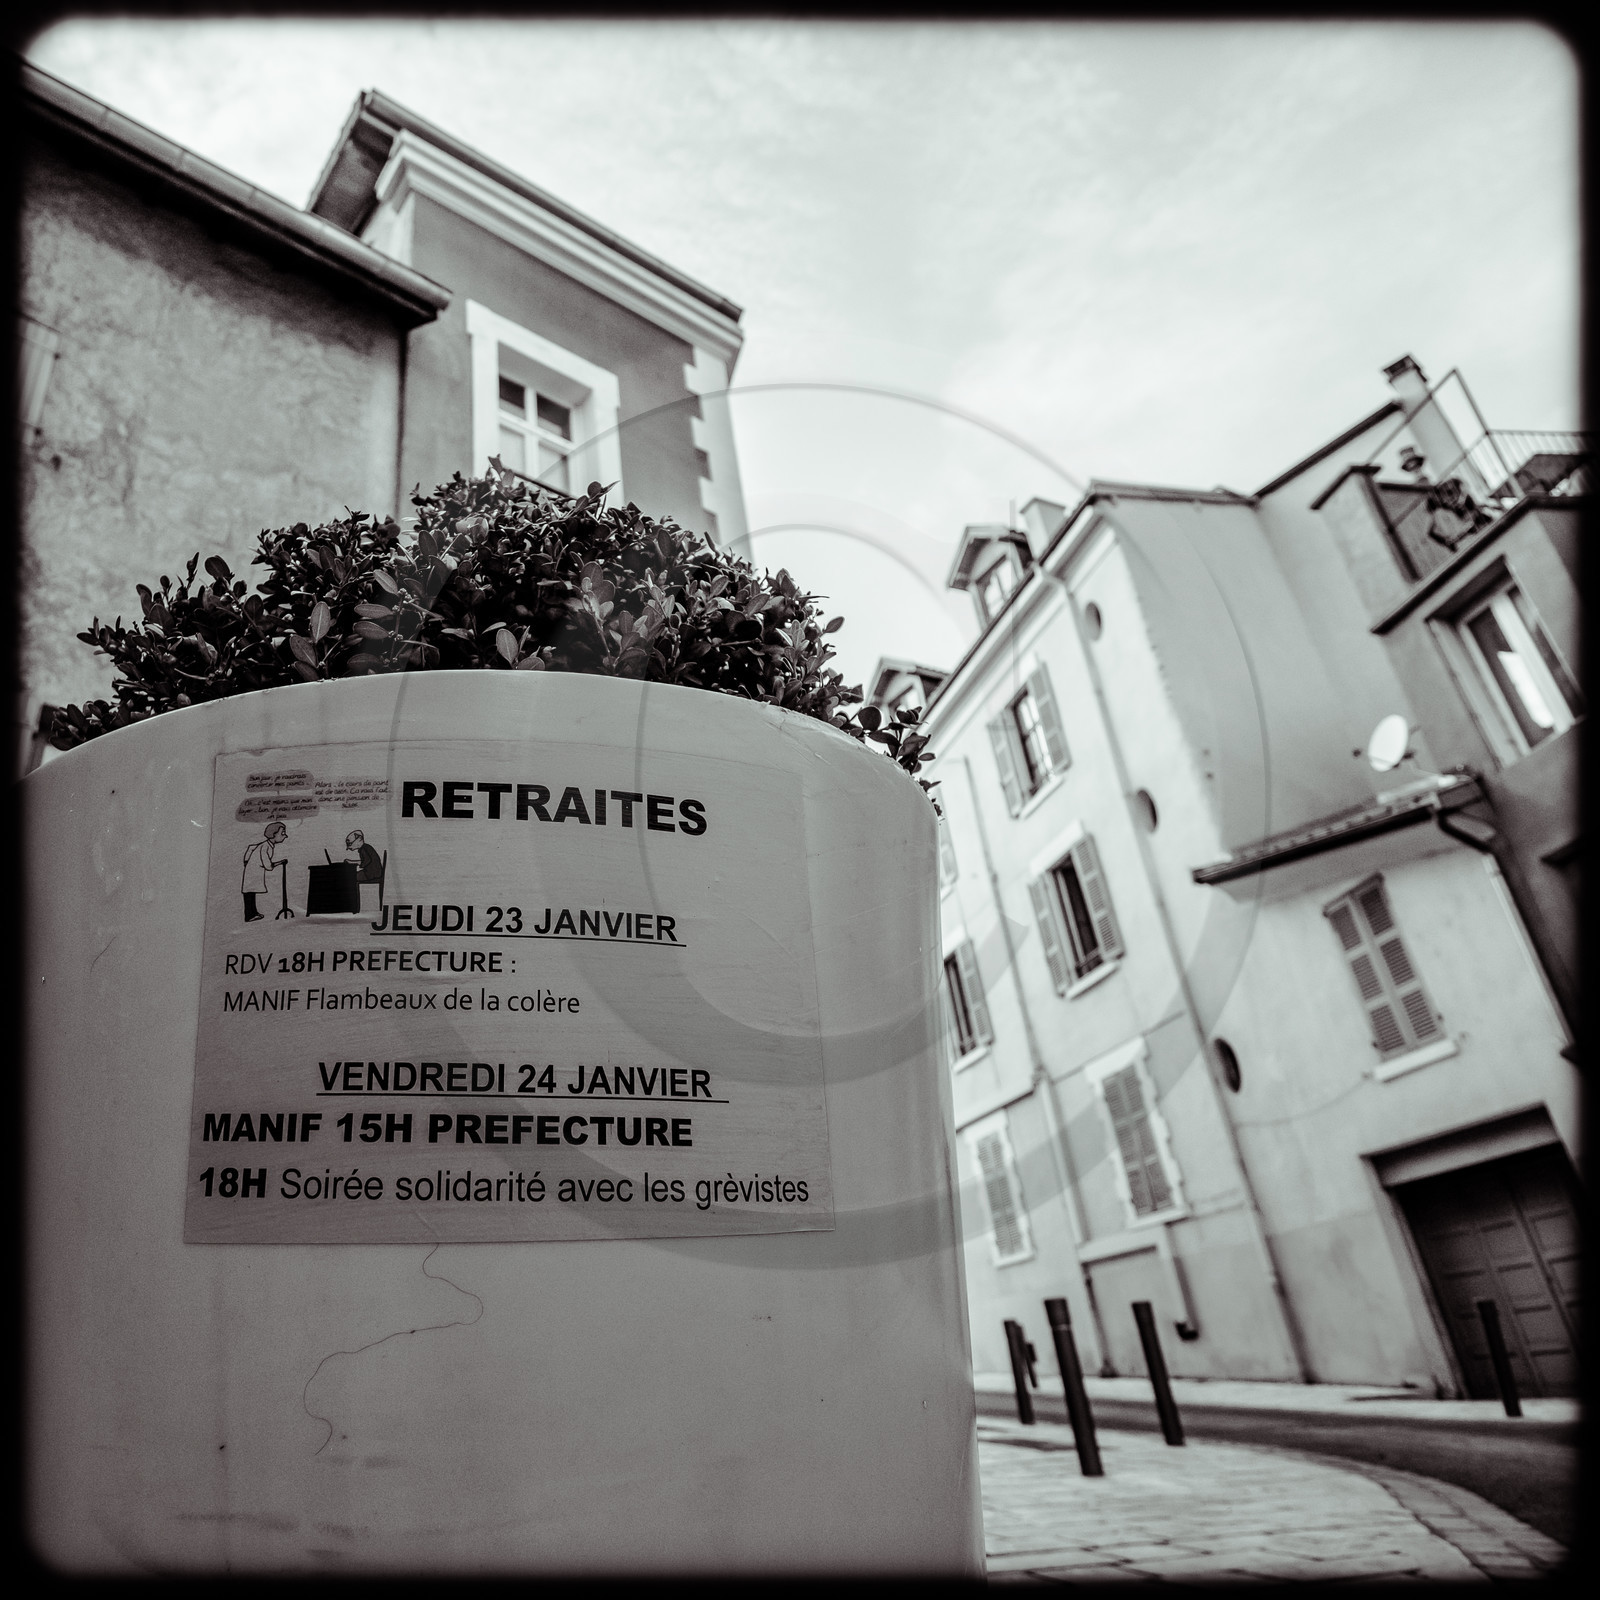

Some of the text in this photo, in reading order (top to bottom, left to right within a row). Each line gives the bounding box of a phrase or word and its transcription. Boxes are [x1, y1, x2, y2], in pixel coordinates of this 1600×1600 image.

[402, 780, 708, 837] RETRAITES
[371, 904, 678, 943] JEUDI 23 JANVIER
[225, 953, 274, 975] RDV
[278, 951, 325, 974] 18H
[333, 950, 503, 974] PREFECTURE
[224, 986, 580, 1014] MANIF Flambeaux de la colère
[318, 1061, 713, 1099] VENDREDI 24 JANVIER
[203, 1112, 693, 1148] MANIF 15H PREFECTURE
[200, 1166, 810, 1211] 18H Soirée solidarité avec les grèvistes
